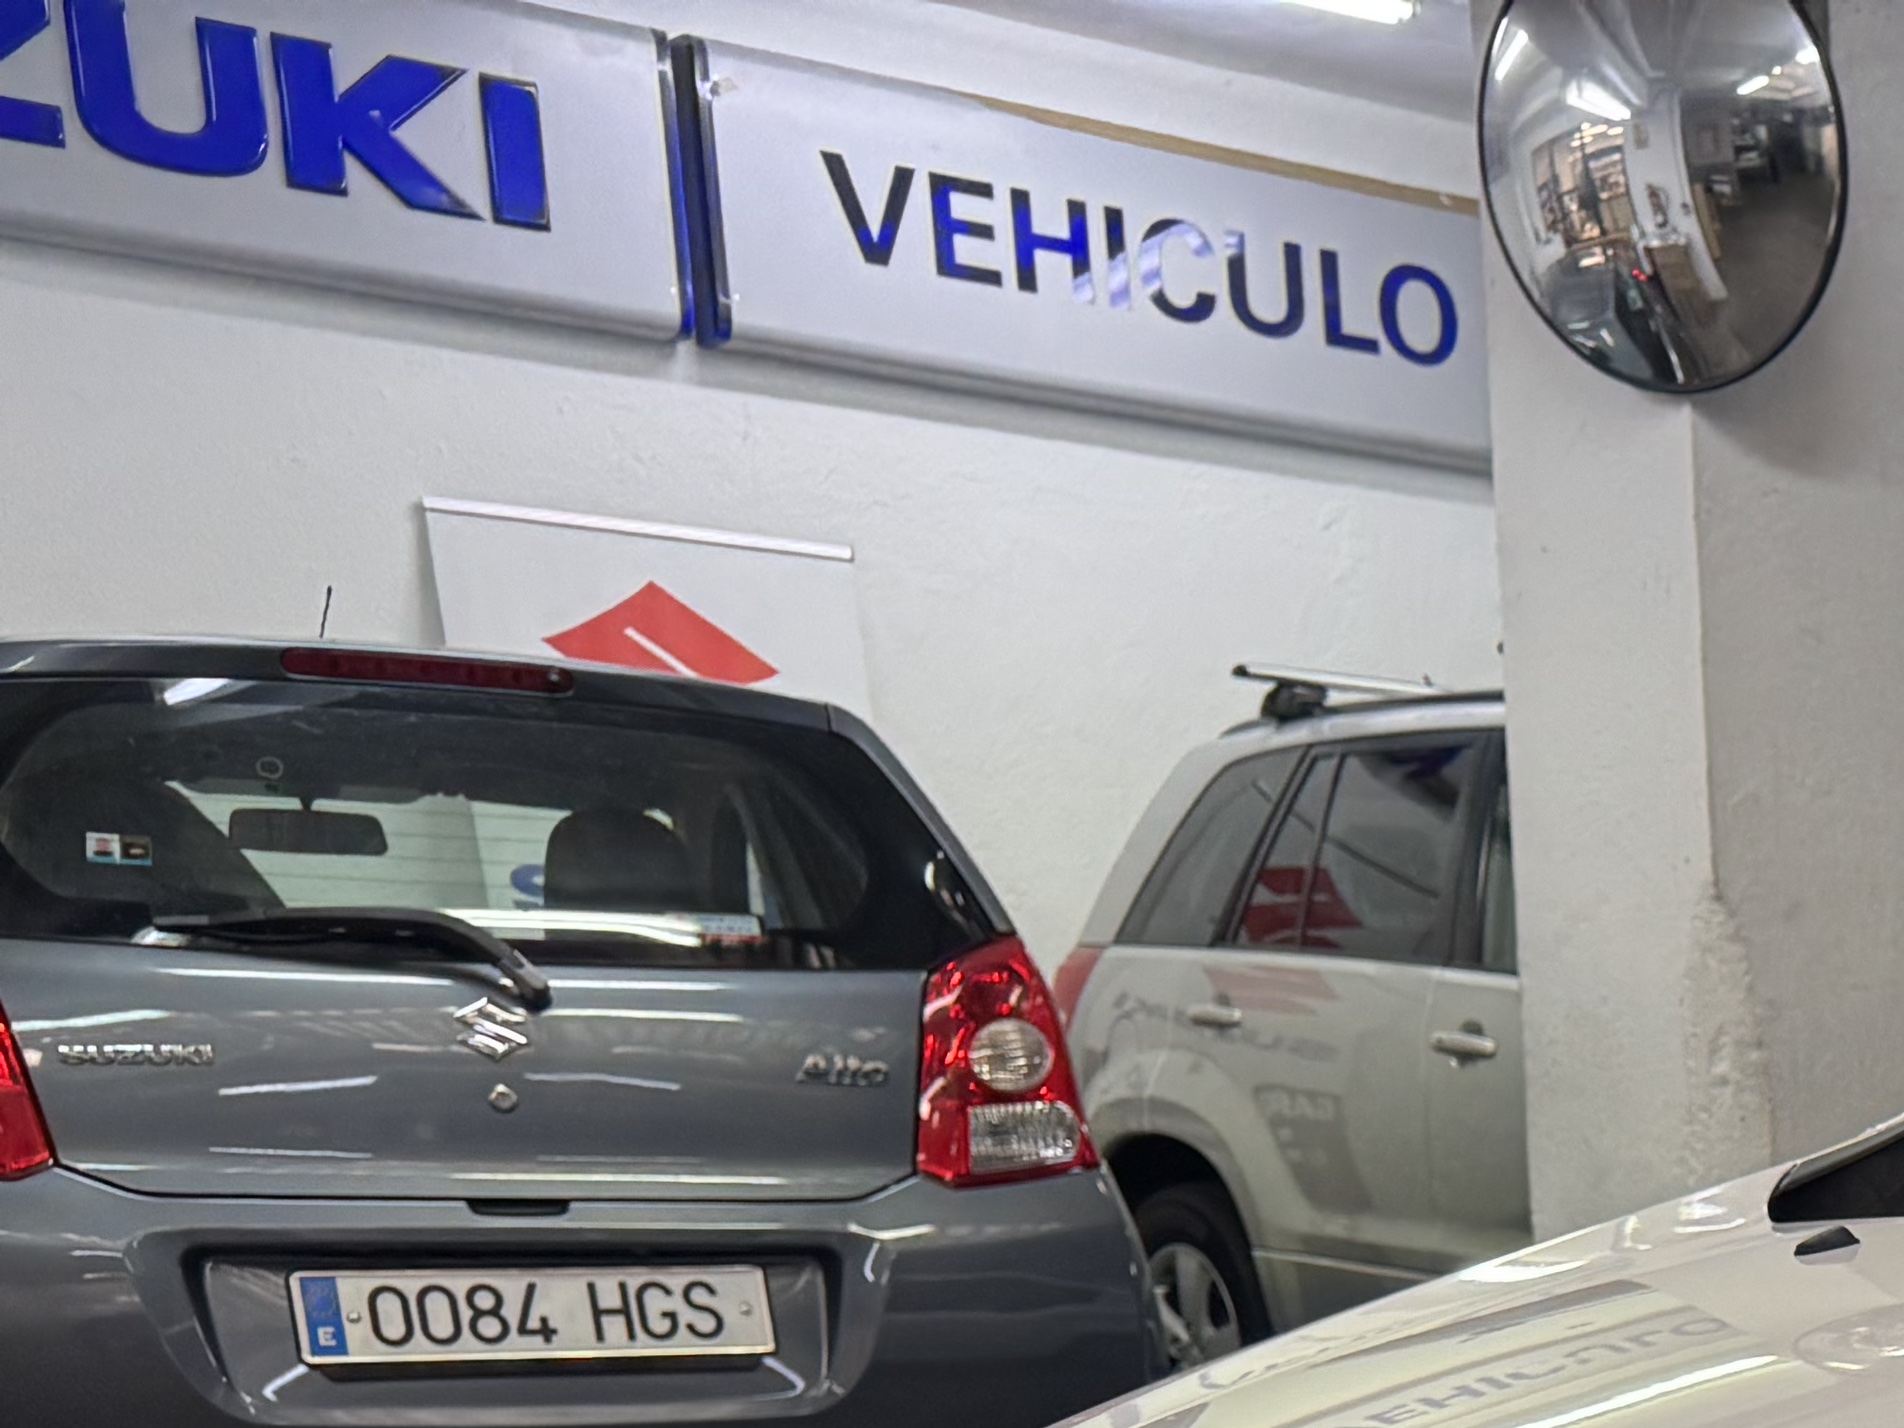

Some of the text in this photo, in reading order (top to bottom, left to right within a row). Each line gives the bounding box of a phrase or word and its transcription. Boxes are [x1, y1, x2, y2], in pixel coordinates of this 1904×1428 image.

[820, 150, 1459, 368] VEHICULO
[57, 1043, 214, 1067] SUZUKI
[796, 1054, 890, 1086] Alto
[367, 1280, 725, 1347] 0084 HGS
[317, 1326, 338, 1347] E
